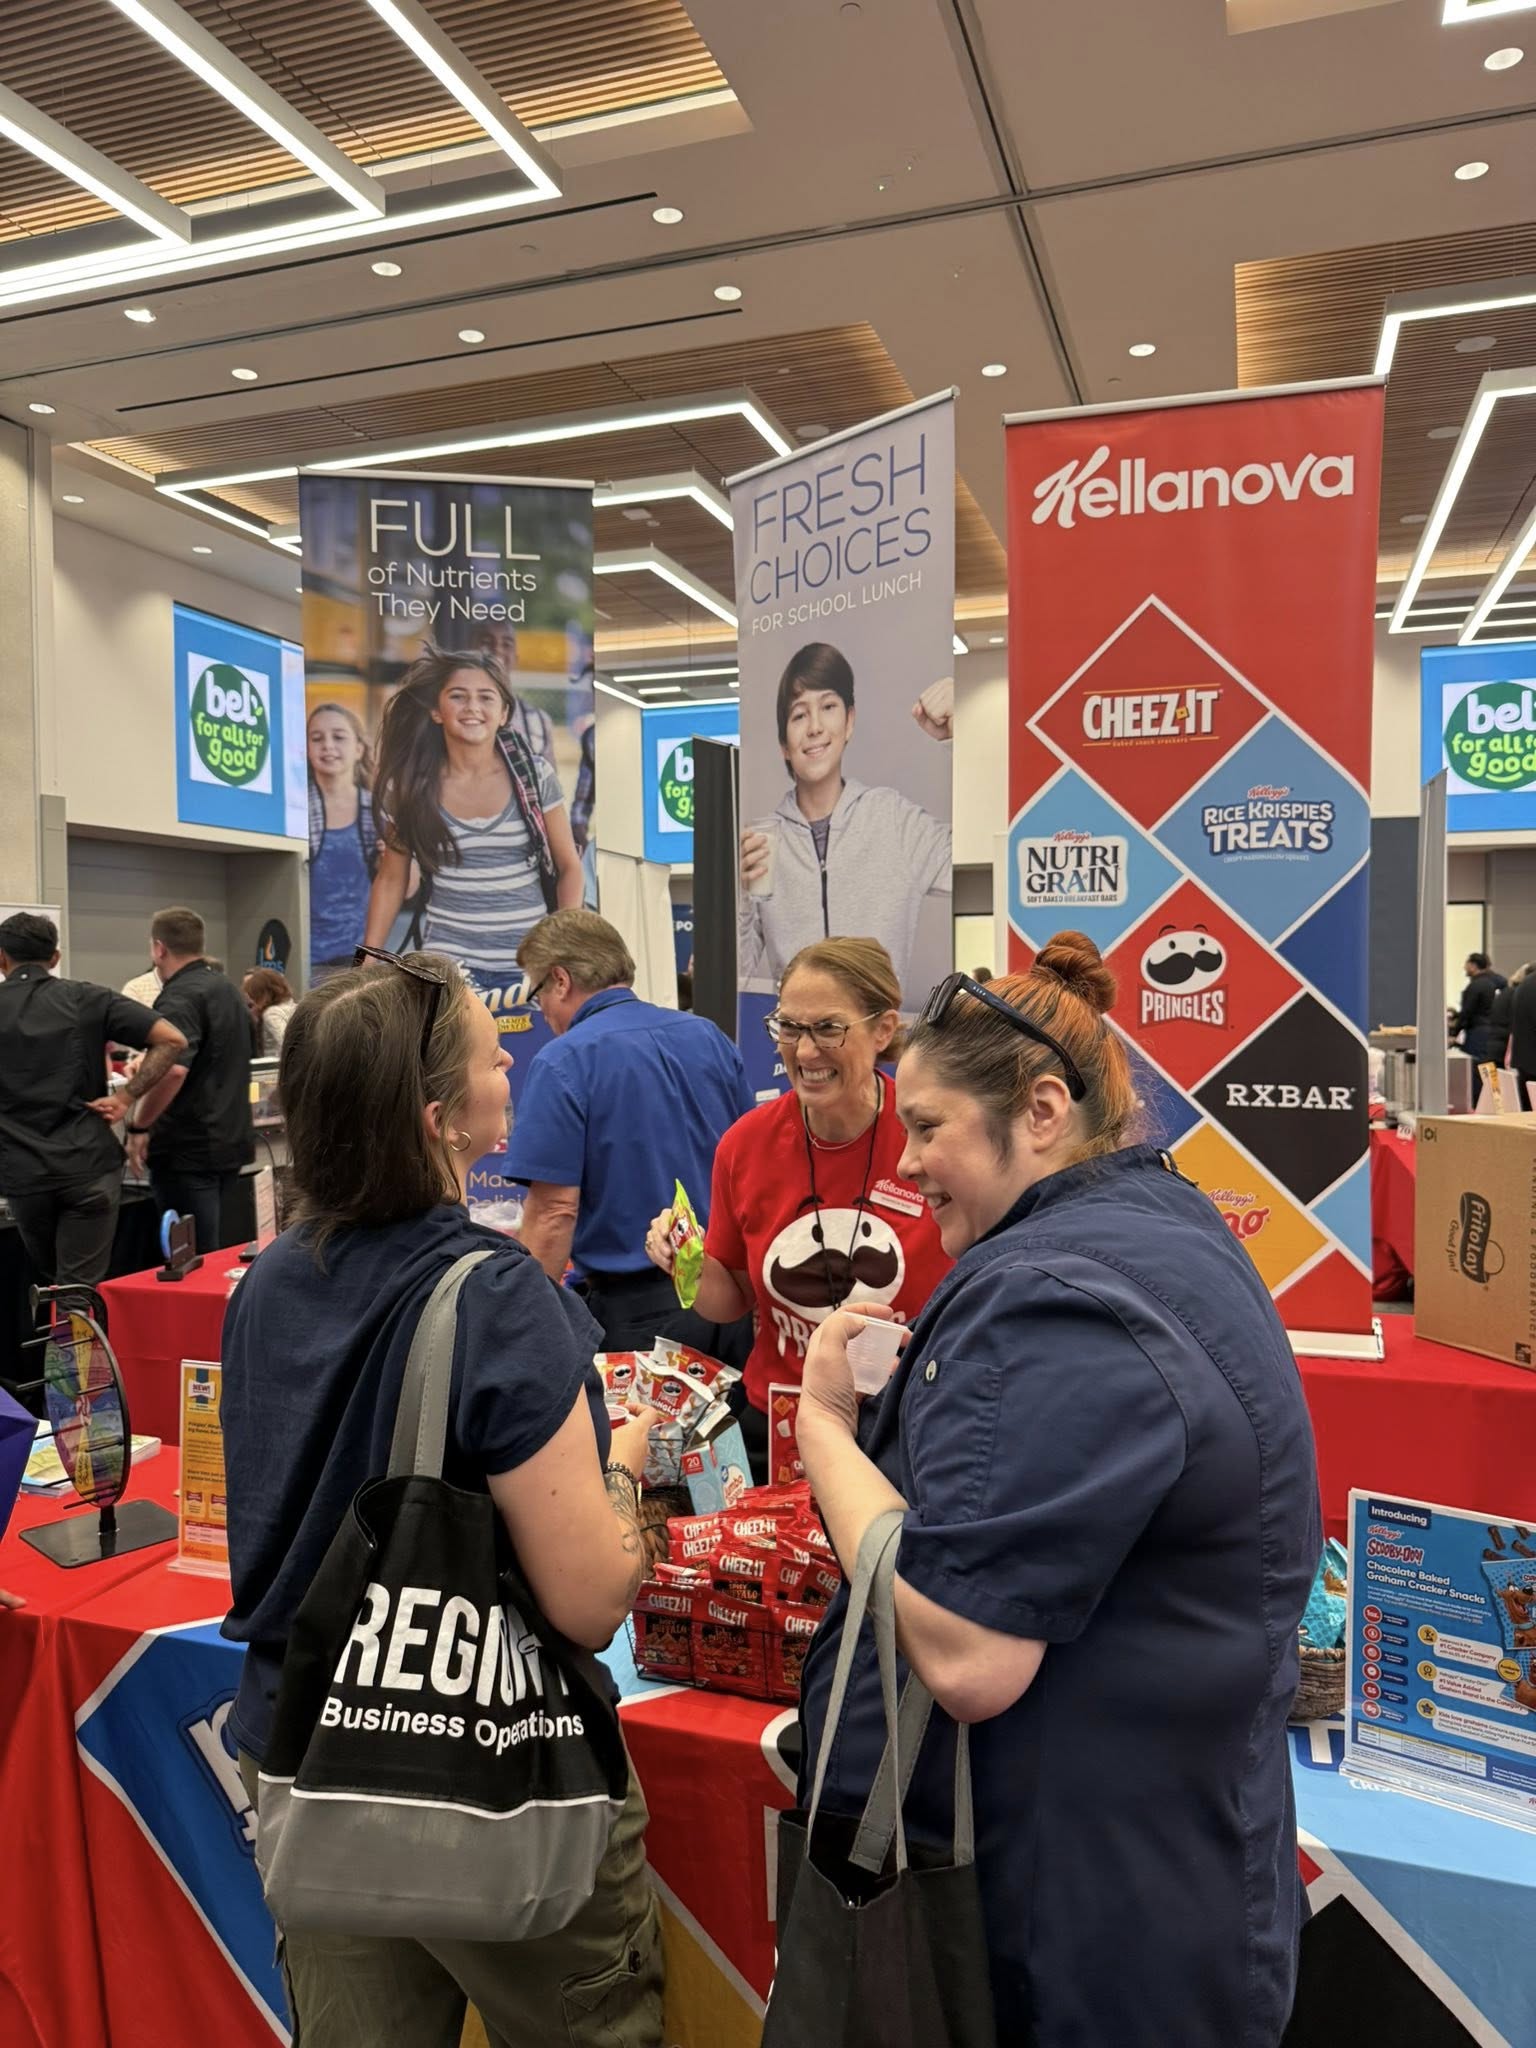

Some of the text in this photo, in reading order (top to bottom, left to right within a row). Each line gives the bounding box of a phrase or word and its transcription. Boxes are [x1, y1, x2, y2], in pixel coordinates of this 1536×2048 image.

[754, 433, 925, 553] FRESH
[1032, 446, 1354, 528] Kellanova
[371, 499, 541, 560] FULL
[750, 507, 931, 604] CHOICES
[367, 562, 537, 592] of Nutrients
[371, 592, 535, 624] They Need
[752, 570, 921, 636] FOR SCHOOL LUNCH
[205, 670, 258, 726] bel
[195, 712, 264, 748] for all for
[1452, 732, 1486, 754] for
[1489, 733, 1524, 753] all
[207, 738, 257, 770] good
[1467, 751, 1536, 778] good
[665, 780, 689, 799] for
[1248, 785, 1290, 799] Kellogg's
[1204, 801, 1333, 823] RICE KRISPIES
[1053, 831, 1091, 842] Kellogg's
[1207, 819, 1331, 854] TREATS
[1026, 845, 1120, 873] NUTRI
[1026, 867, 1119, 894] GRAIN
[1101, 894, 1118, 902] BARS
[478, 972, 531, 1013] nd
[1141, 989, 1224, 1027] PRINGLES
[1226, 1083, 1354, 1110] RXBAR
[874, 1179, 924, 1203] Kellanova
[1207, 1189, 1255, 1206] Kellogg's
[1445, 1219, 1459, 1273] Good fun!
[686, 1457, 700, 1467] 20
[1370, 1505, 1428, 1528] Introducing
[1367, 1524, 1402, 1541] Kellogg's
[1367, 1538, 1424, 1566] SCOOBY-DOO!
[1366, 1560, 1450, 1585] Chocolate Baked
[1366, 1571, 1407, 1588] Graham
[1407, 1579, 1448, 1597] Cracker
[1448, 1588, 1486, 1605] Snacks
[320, 1696, 585, 1755] Business Operations
